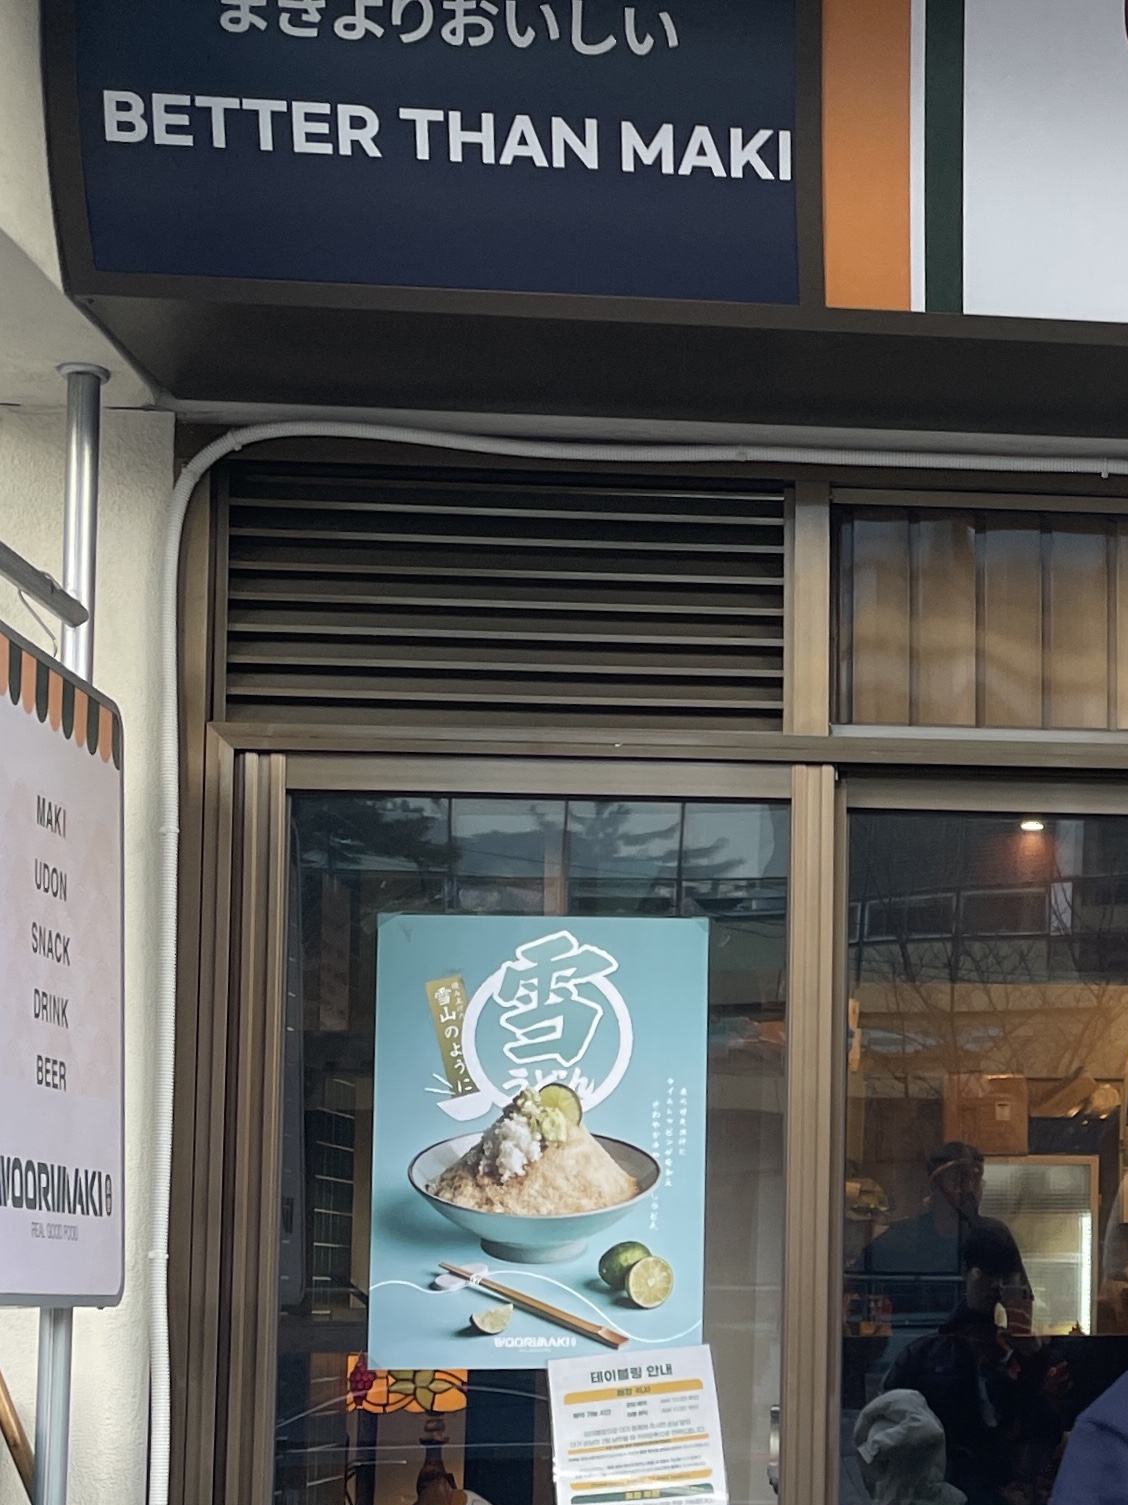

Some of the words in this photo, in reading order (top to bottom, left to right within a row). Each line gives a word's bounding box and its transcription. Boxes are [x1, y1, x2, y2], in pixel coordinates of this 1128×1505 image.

[102, 89, 382, 158] BETTER
[399, 107, 600, 171] THAN
[621, 123, 794, 182] MAKI
[36, 795, 67, 839] MAKI
[34, 858, 68, 902] UDON
[31, 921, 72, 967] SNACK
[33, 988, 69, 1029] DRINK
[491, 929, 620, 1068] 雪
[434, 987, 473, 1094] 雪山のように
[36, 1054, 68, 1092] BEER
[590, 1367, 642, 1384] 테이블링
[646, 1364, 673, 1378] 안내
